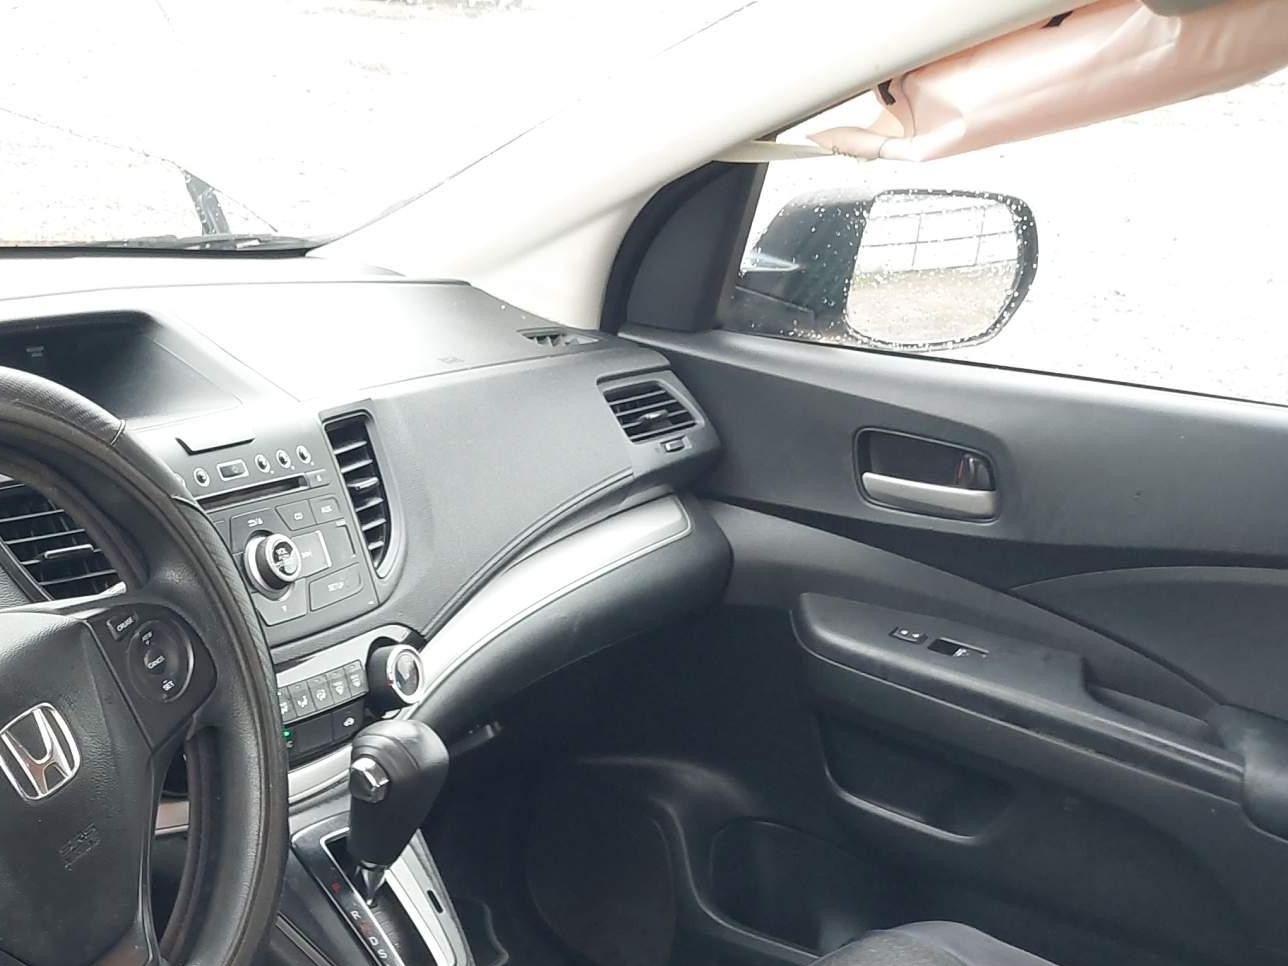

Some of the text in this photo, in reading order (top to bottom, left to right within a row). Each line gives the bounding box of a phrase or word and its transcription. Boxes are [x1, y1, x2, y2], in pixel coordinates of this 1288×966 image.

[350, 910, 361, 920] R
[368, 936, 379, 946] D
[377, 949, 388, 959] S
